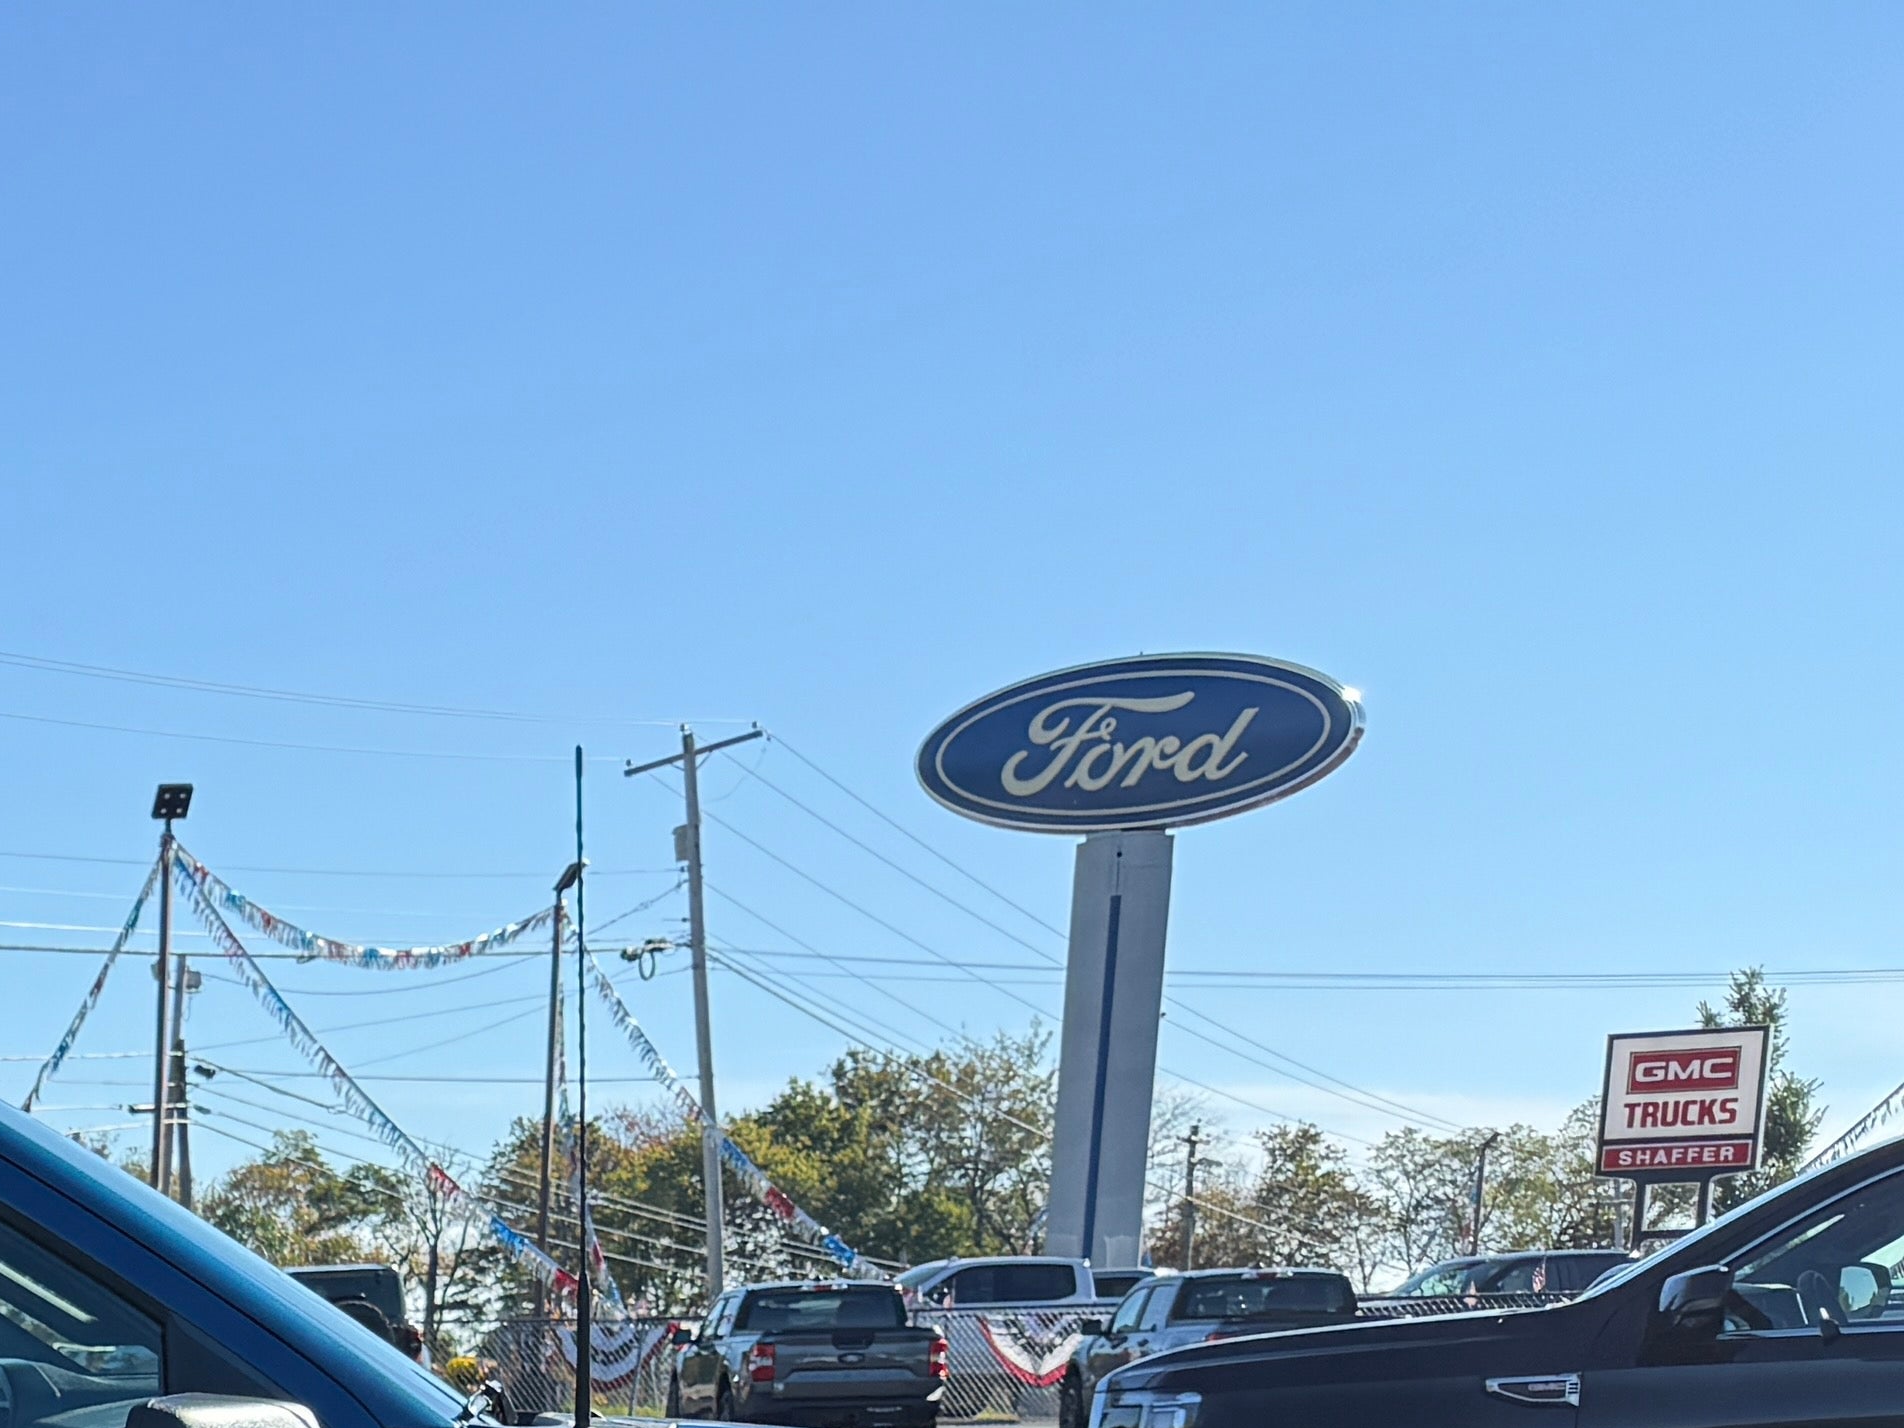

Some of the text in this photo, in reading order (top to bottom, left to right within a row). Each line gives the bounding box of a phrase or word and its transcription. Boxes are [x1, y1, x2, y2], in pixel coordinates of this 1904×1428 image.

[1001, 691, 1259, 797] Ford
[1634, 1057, 1734, 1083] GMC
[1623, 1097, 1739, 1128] TRUCKS
[1618, 1145, 1735, 1166] SHAFFER
